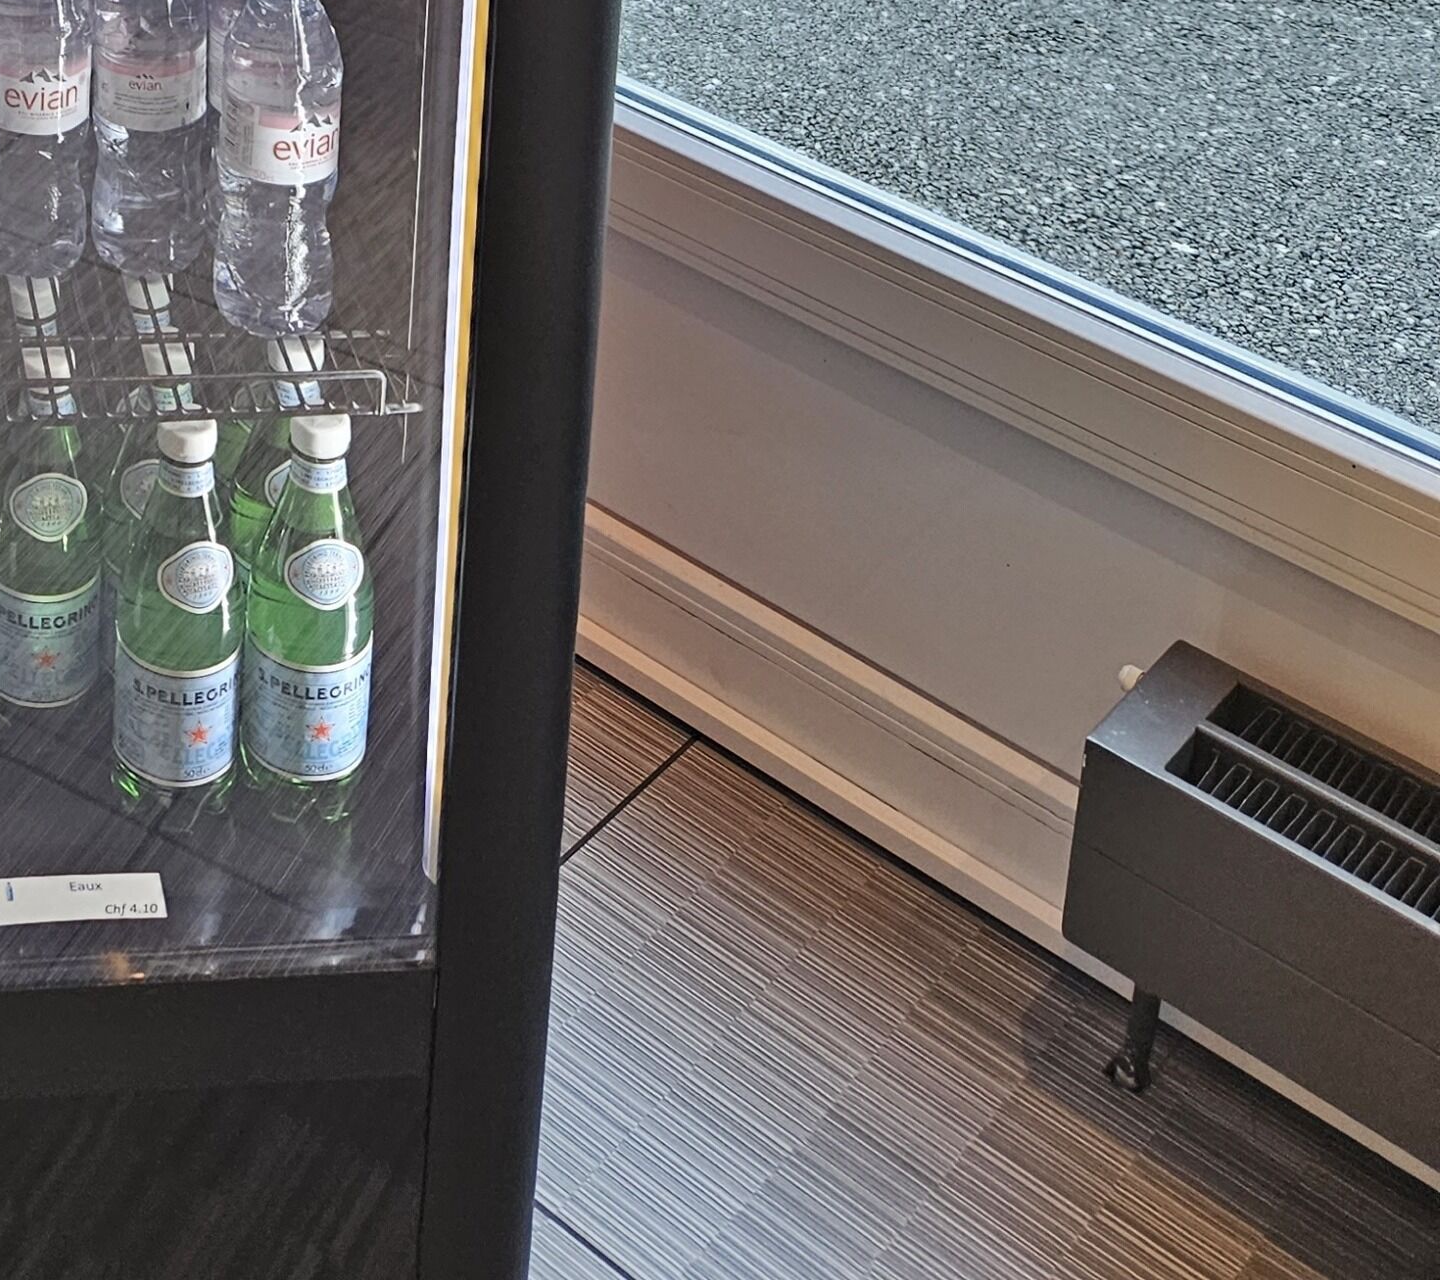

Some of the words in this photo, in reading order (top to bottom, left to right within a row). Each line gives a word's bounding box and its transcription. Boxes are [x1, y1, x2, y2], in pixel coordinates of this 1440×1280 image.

[128, 79, 163, 91] evian
[4, 84, 78, 112] evian
[69, 881, 103, 892] Eaux
[105, 903, 127, 917] Chf
[129, 902, 159, 914] 4.10
